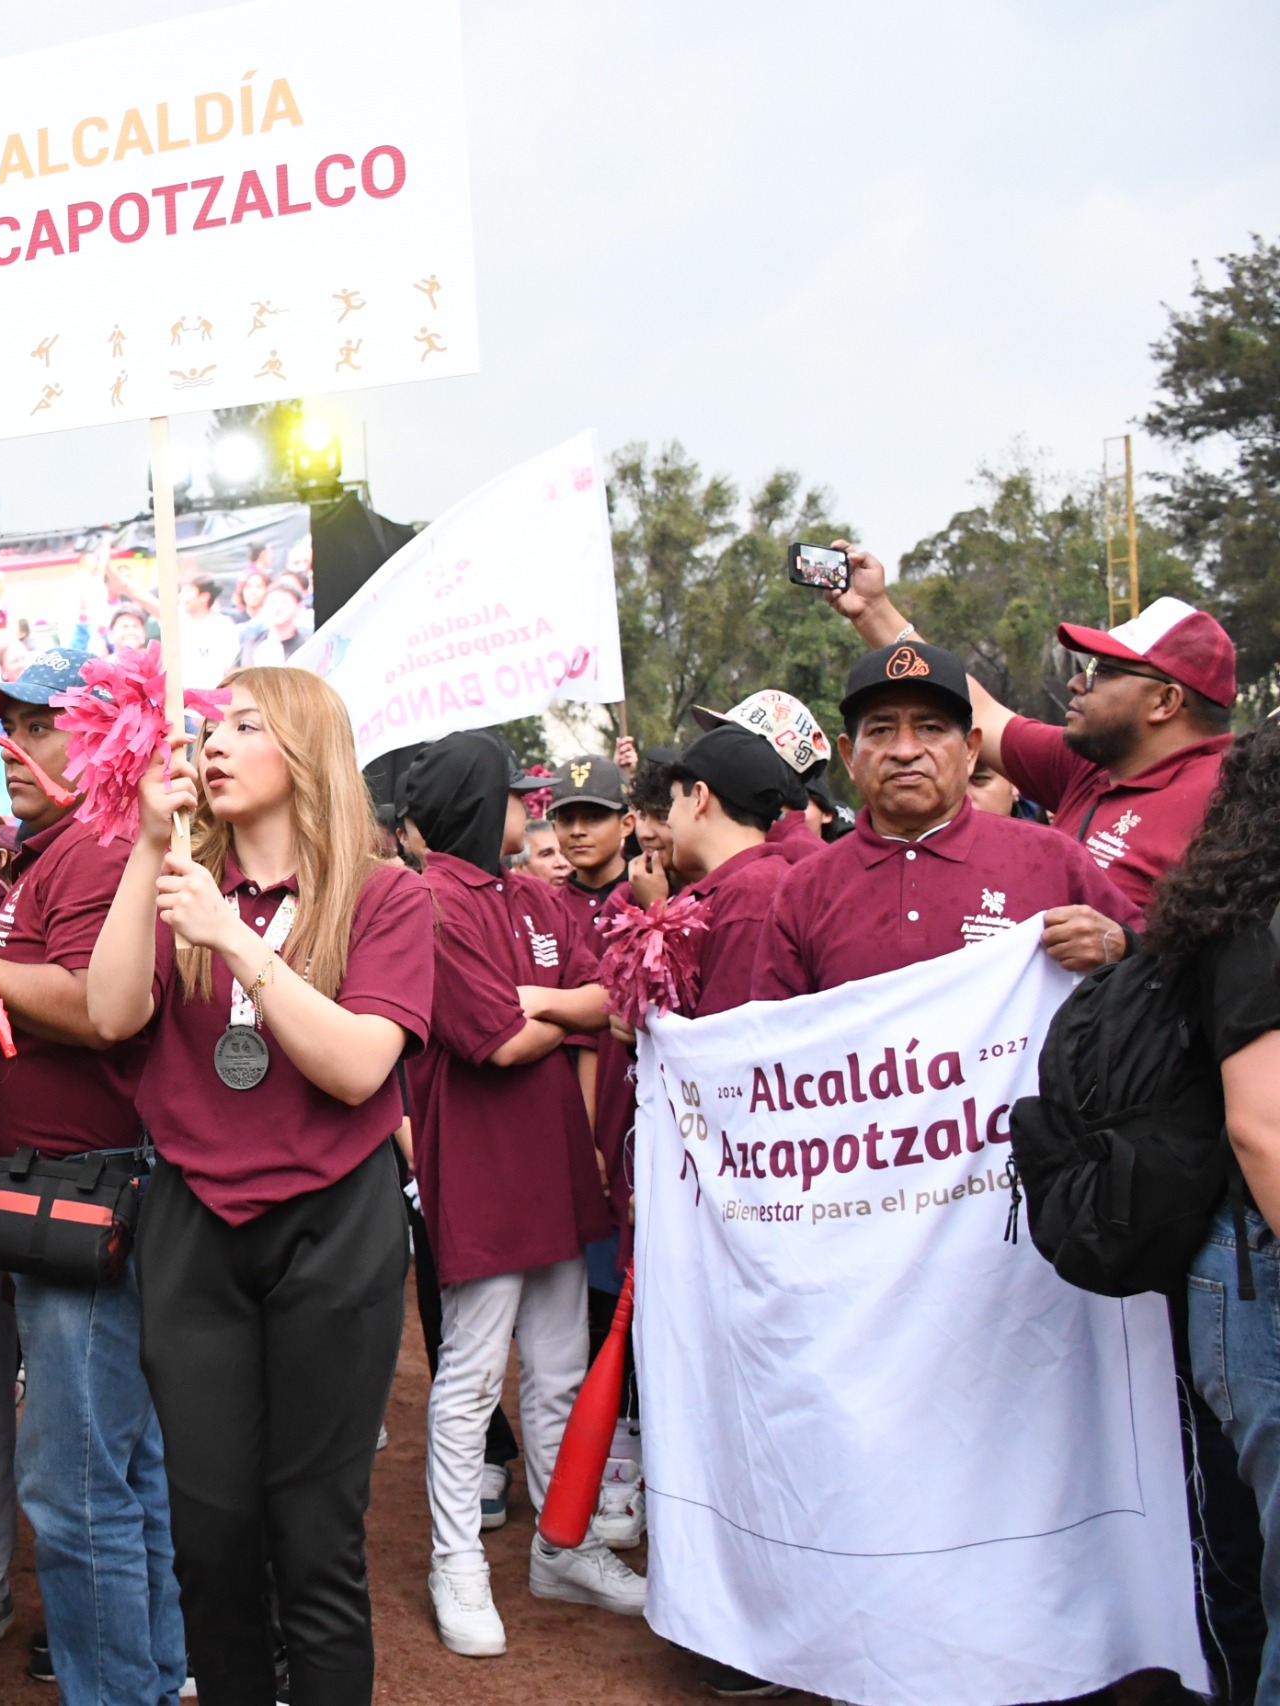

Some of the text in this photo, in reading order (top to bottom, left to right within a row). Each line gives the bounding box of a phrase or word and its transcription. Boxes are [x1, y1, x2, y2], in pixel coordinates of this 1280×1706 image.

[718, 1037, 1029, 1113] 2024 Alcaldía 2027
[722, 1168, 1022, 1225] ¡Bienestar para el pueblo
